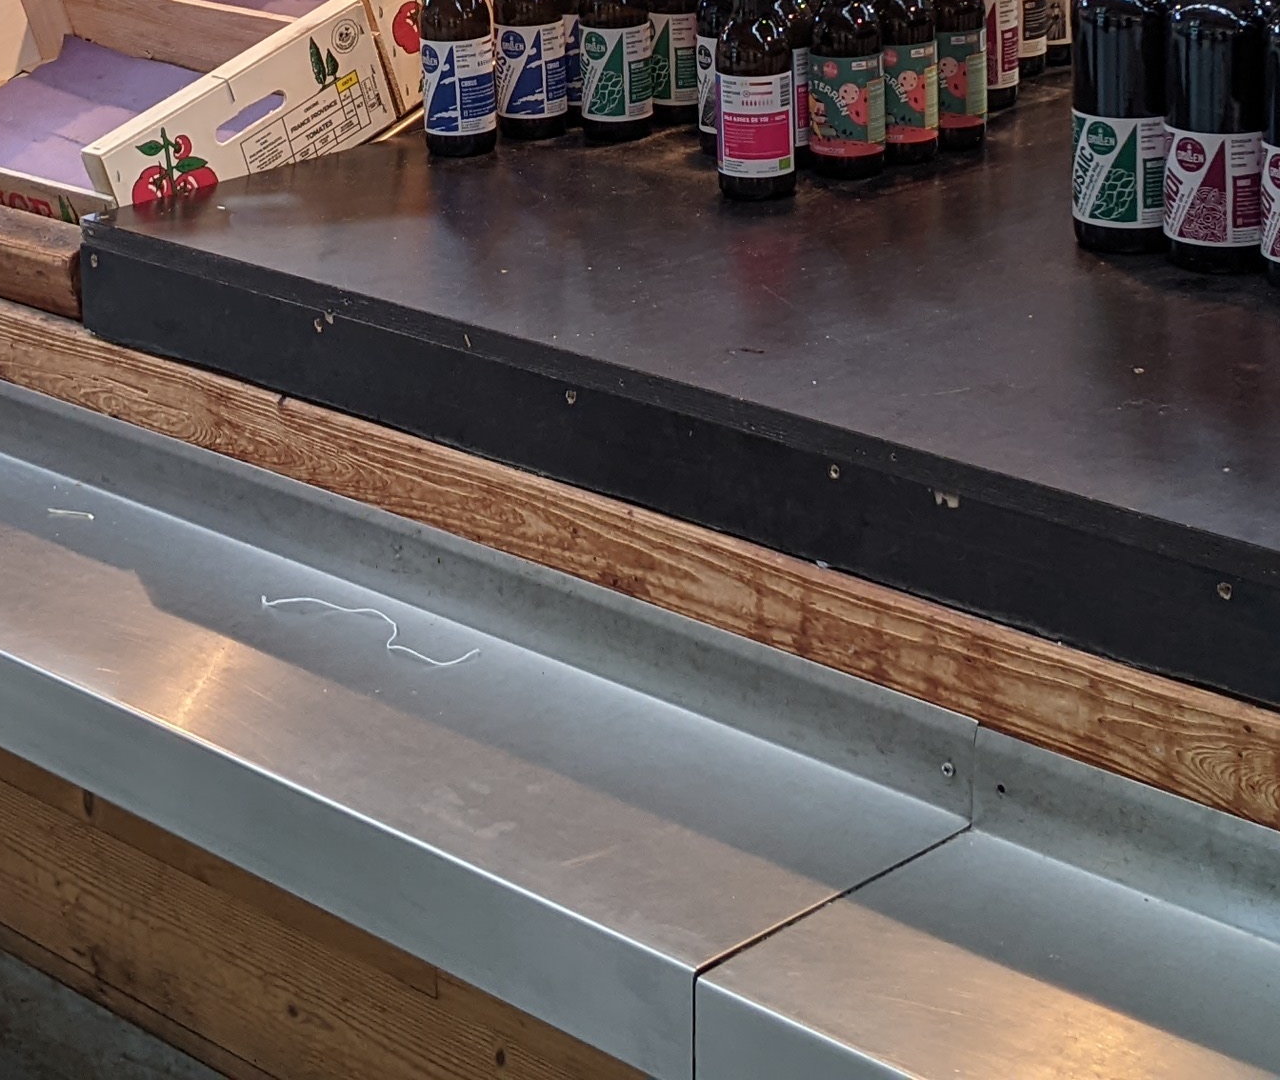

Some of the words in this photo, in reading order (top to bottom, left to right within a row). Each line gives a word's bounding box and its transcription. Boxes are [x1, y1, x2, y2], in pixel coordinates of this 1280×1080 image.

[813, 79, 850, 117] TERRIEN
[883, 72, 910, 104] RRIEN
[290, 114, 311, 134] FRANCE
[310, 98, 339, 121] PROVENCE
[304, 119, 335, 142] TOMATES
